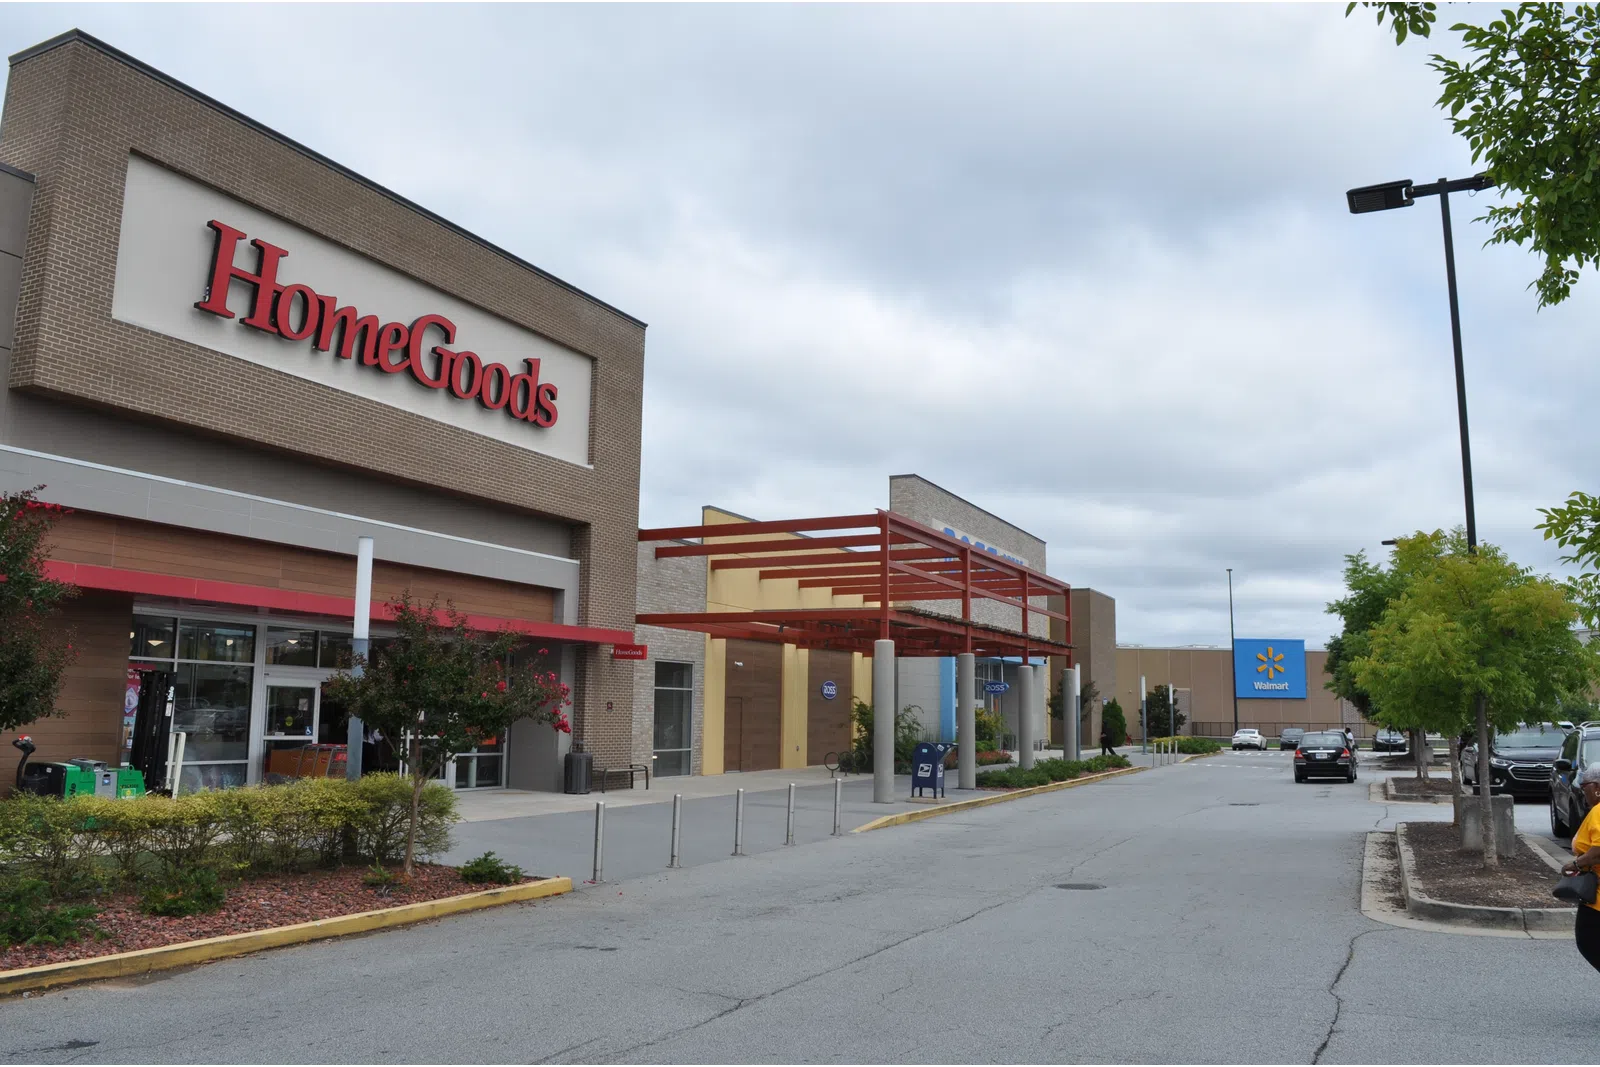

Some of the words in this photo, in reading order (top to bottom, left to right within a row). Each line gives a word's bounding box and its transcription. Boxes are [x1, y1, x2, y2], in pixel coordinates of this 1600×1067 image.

[194, 219, 558, 428] HomeGoods
[823, 685, 836, 695] ROSS
[1253, 682, 1289, 690] Walmart
